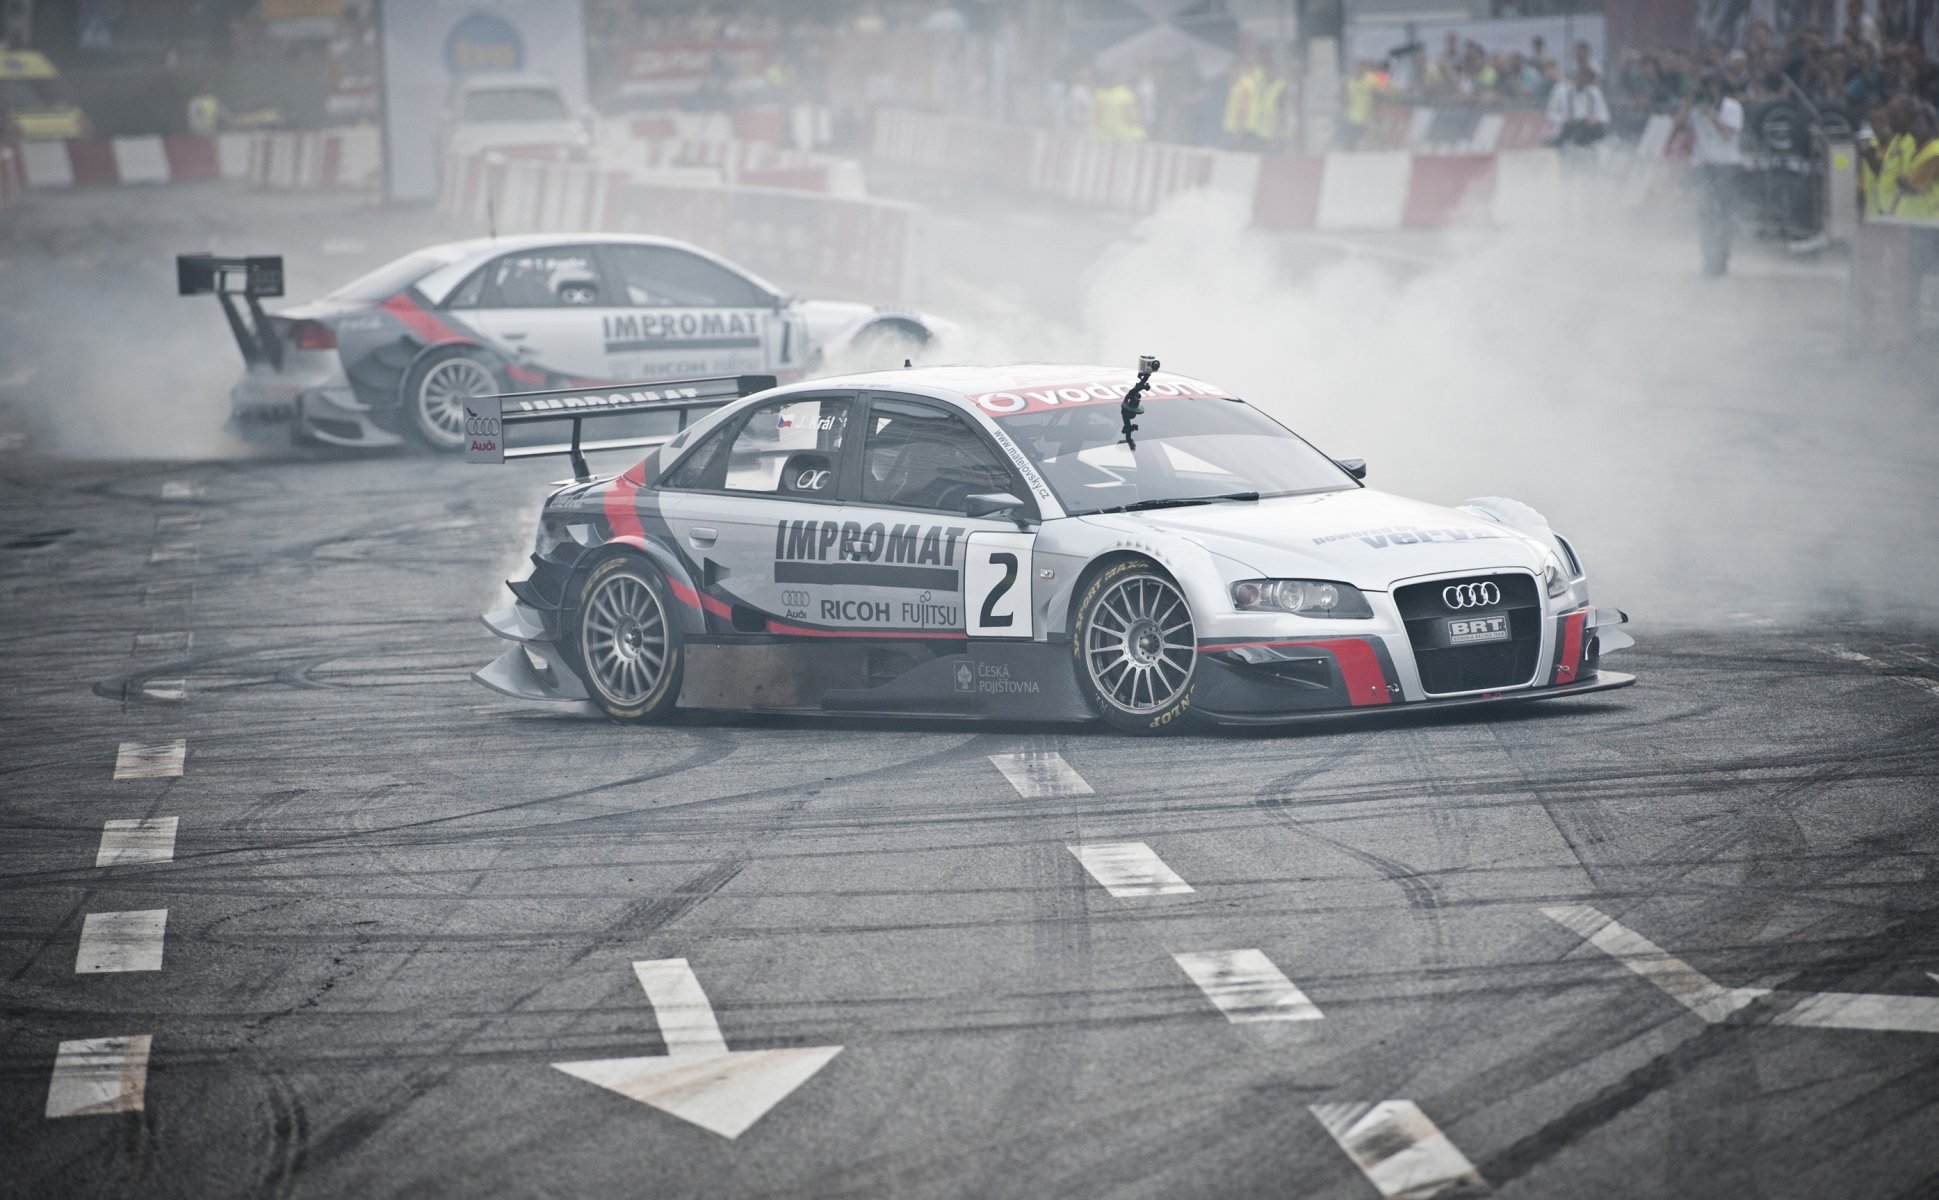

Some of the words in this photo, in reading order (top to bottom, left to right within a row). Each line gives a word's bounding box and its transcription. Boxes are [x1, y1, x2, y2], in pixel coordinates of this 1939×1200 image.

[603, 313, 758, 338] IMPROMAT
[1025, 380, 1219, 406] vodaone
[471, 440, 496, 452] Audi
[994, 429, 1050, 500] www.matejovsky.cz
[775, 519, 966, 567] IMPROMAT
[979, 552, 1018, 628] 2
[786, 608, 807, 620] Audi
[820, 599, 891, 622] RICOH
[902, 602, 958, 628] FUJITSU
[1452, 619, 1503, 635] BRT
[979, 664, 1010, 678] ČESKÁ
[979, 679, 1040, 694] POJIŠŤOVNA
